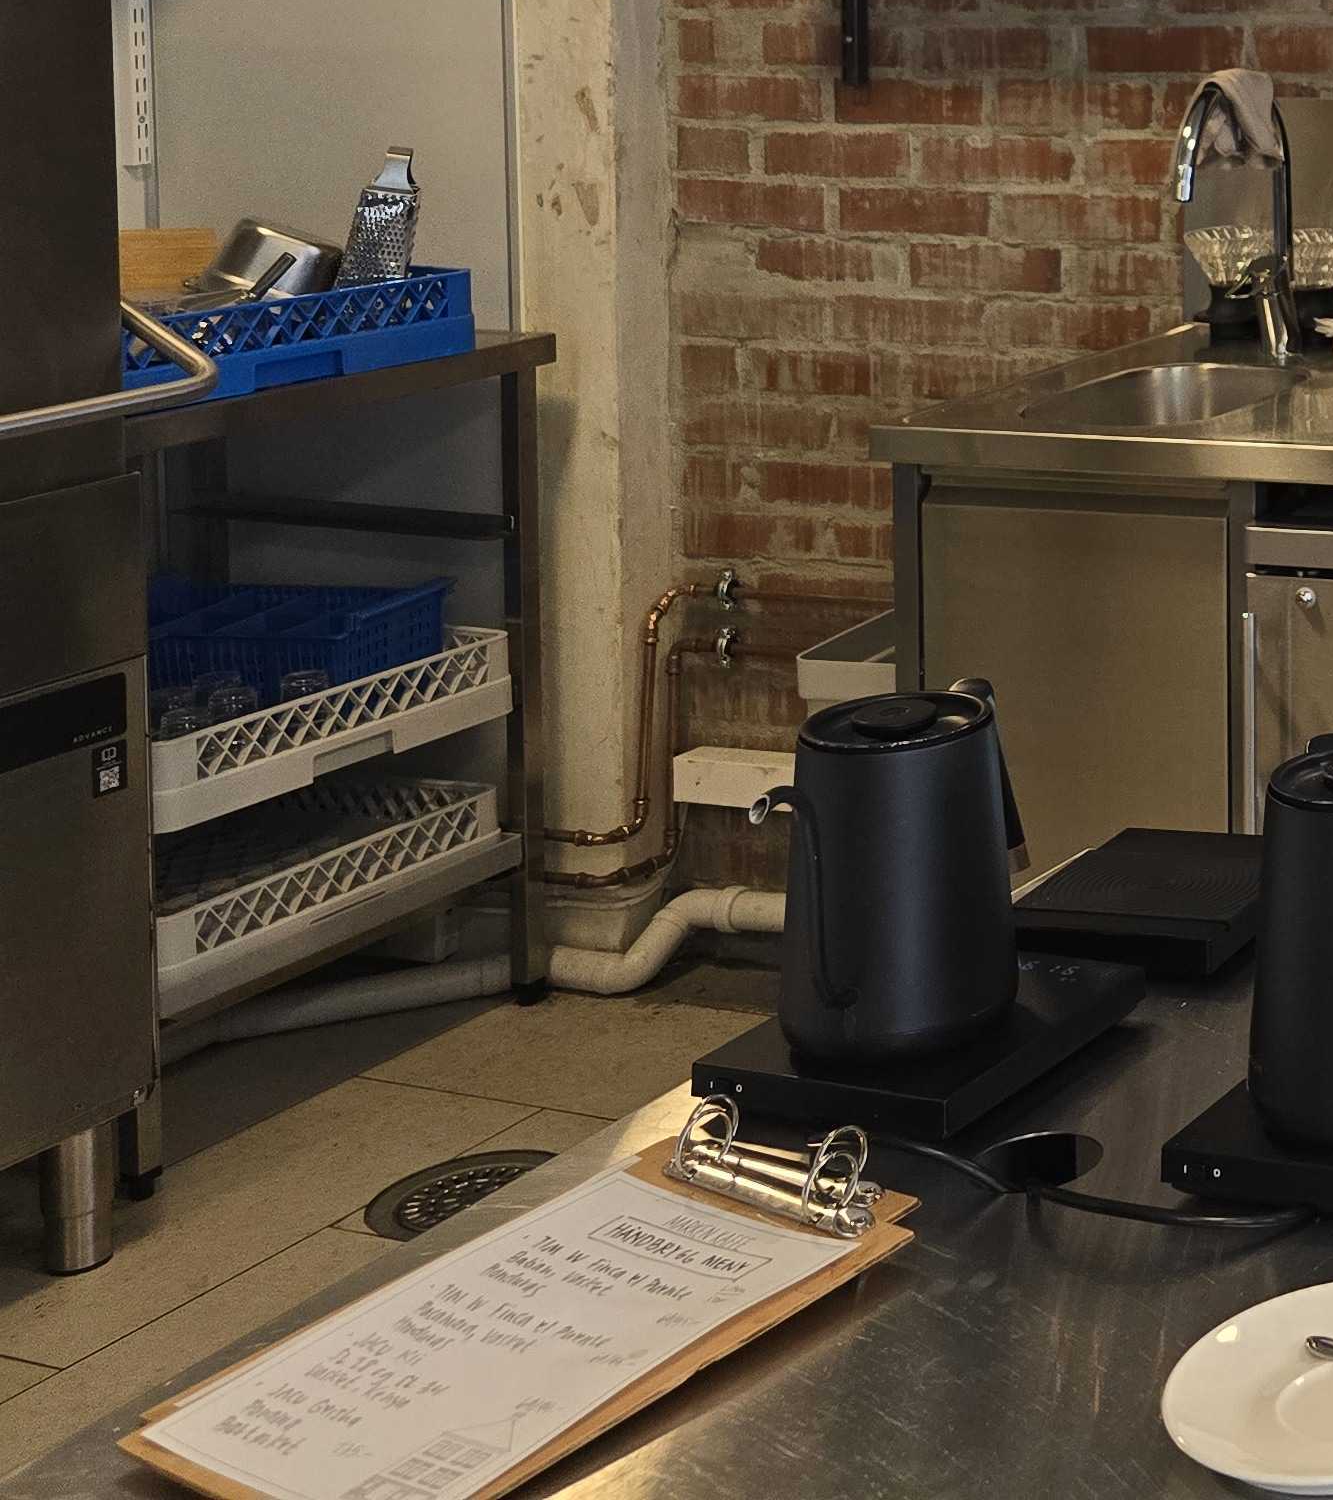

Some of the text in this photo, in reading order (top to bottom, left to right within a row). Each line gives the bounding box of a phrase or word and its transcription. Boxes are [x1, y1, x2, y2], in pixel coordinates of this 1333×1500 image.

[608, 1223, 749, 1272] HÅNDBRYGG MENY
[663, 1215, 756, 1252] MARKEN KAFFE
